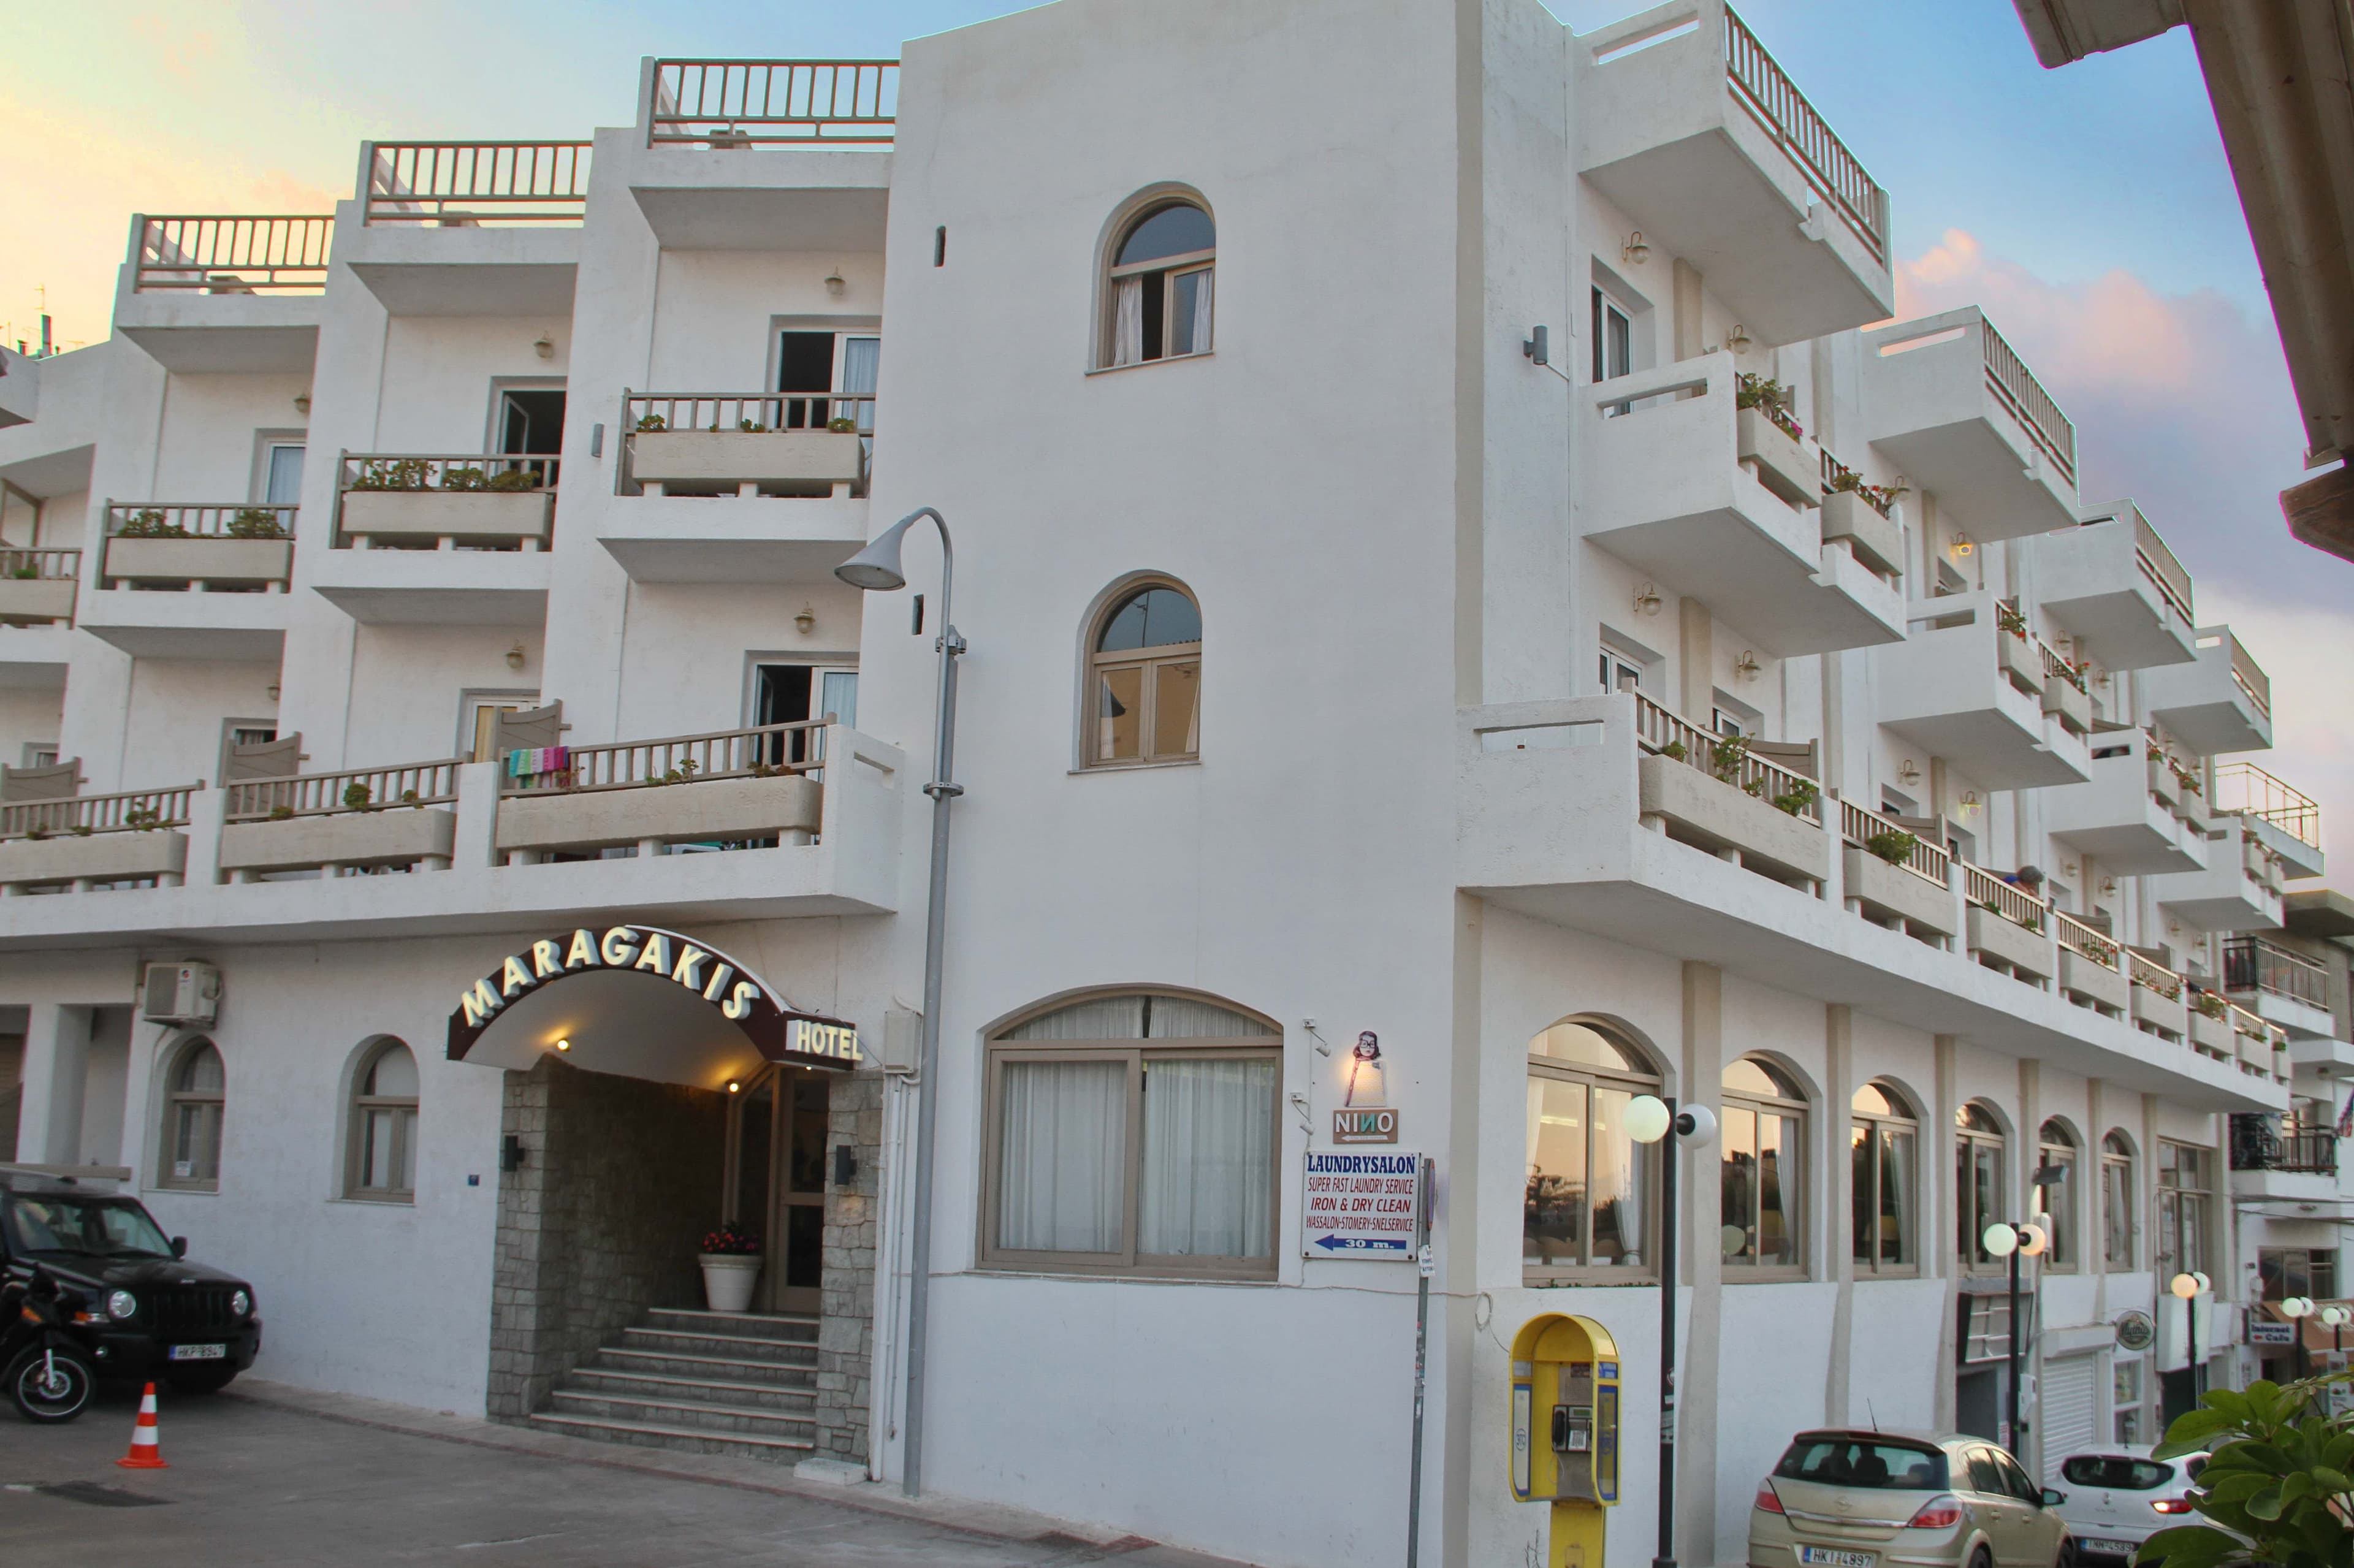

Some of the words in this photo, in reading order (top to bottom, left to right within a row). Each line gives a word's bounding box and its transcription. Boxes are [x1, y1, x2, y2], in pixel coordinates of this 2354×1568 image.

[461, 926, 760, 1028] MARAGAKIS
[787, 1019, 864, 1061] HOTEL
[1307, 1155, 1415, 1174] LAUNDRYSALON
[1308, 1177, 1331, 1192] SUPER
[1332, 1178, 1349, 1193] FAST
[1350, 1178, 1384, 1193] LAUNDRY
[1385, 1179, 1414, 1195] SERVICE
[1311, 1197, 1337, 1211] IRON
[1340, 1198, 1347, 1211] &
[1352, 1198, 1374, 1212] DRY
[1376, 1199, 1411, 1213] CLEAN
[1345, 1239, 1366, 1248] 30
[2250, 1324, 2291, 1333] Internet
